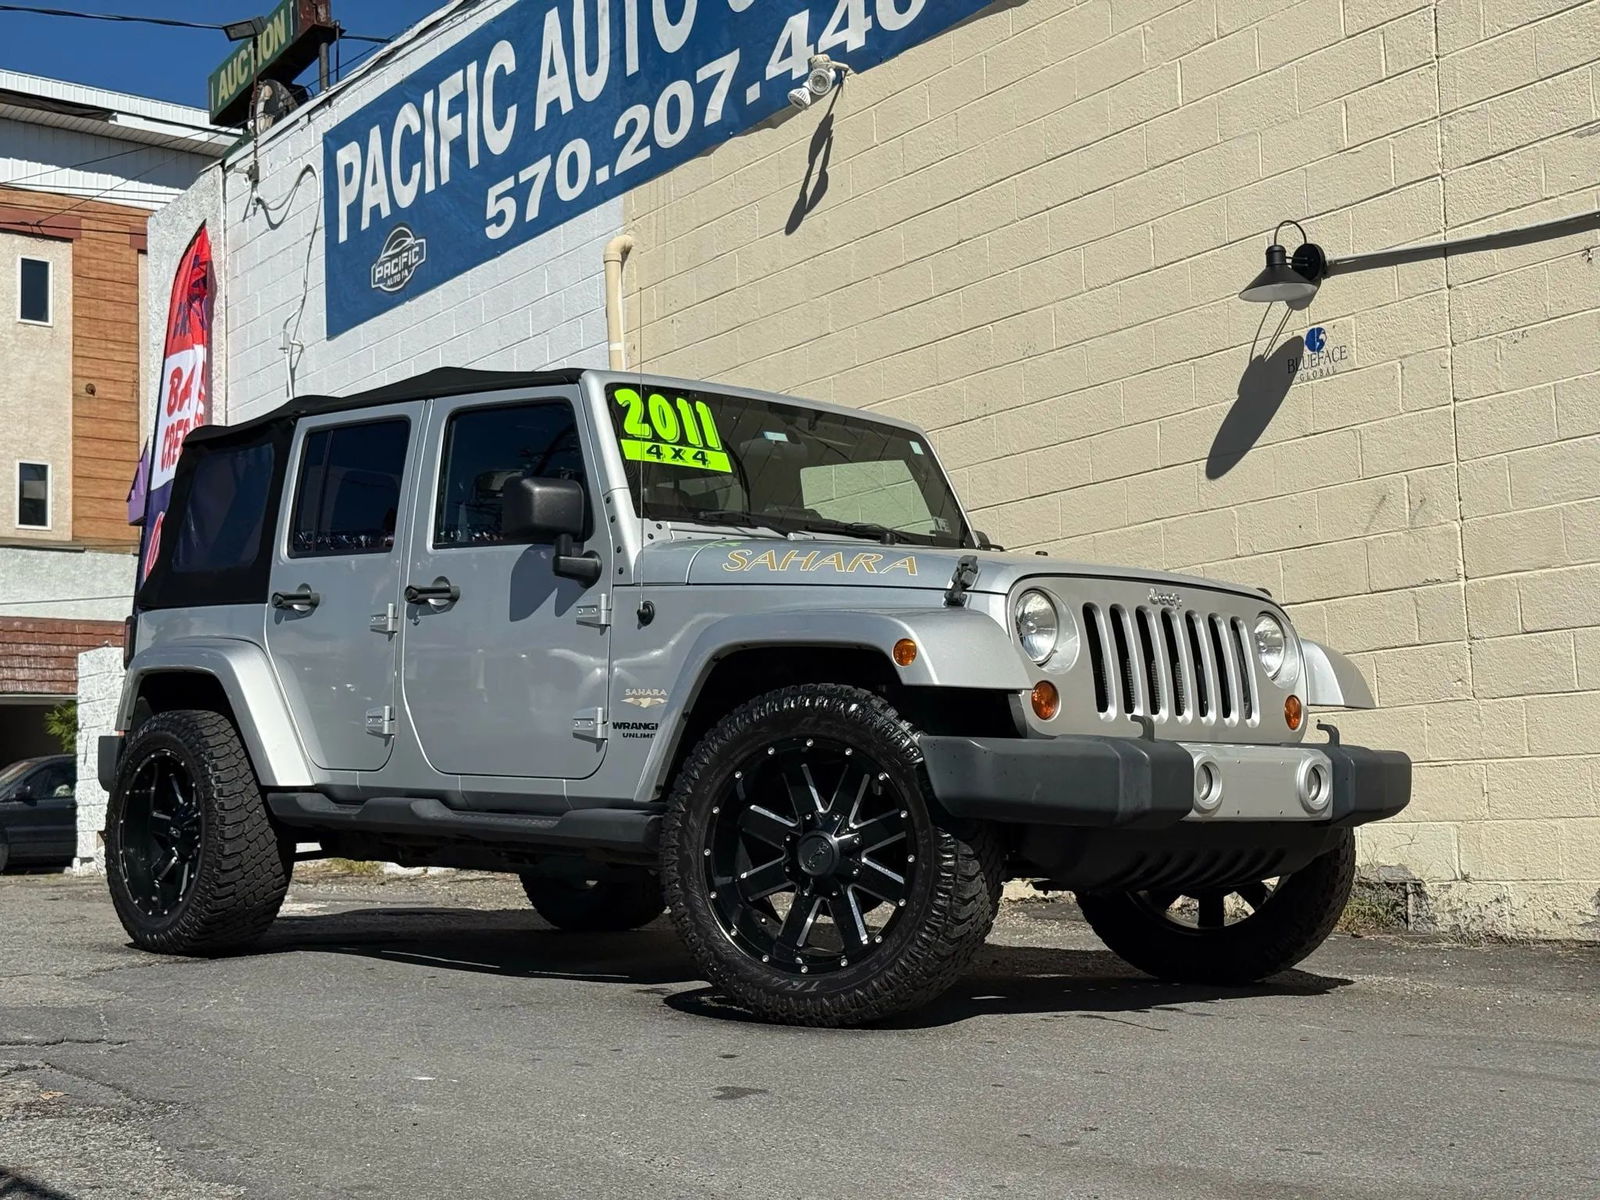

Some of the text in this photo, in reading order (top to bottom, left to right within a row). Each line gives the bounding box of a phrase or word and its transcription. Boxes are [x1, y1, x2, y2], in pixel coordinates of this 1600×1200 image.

[217, 9, 286, 107] AUCTION
[336, 39, 518, 244] PACIFIC
[374, 247, 420, 283] PACIFIC
[1287, 345, 1349, 374] BLUEFACE
[1299, 366, 1338, 382] GLOBAL
[614, 388, 723, 451] 2011
[722, 549, 918, 576] SAHARA
[1147, 586, 1183, 610] Jeep
[624, 688, 668, 696] SAHARA
